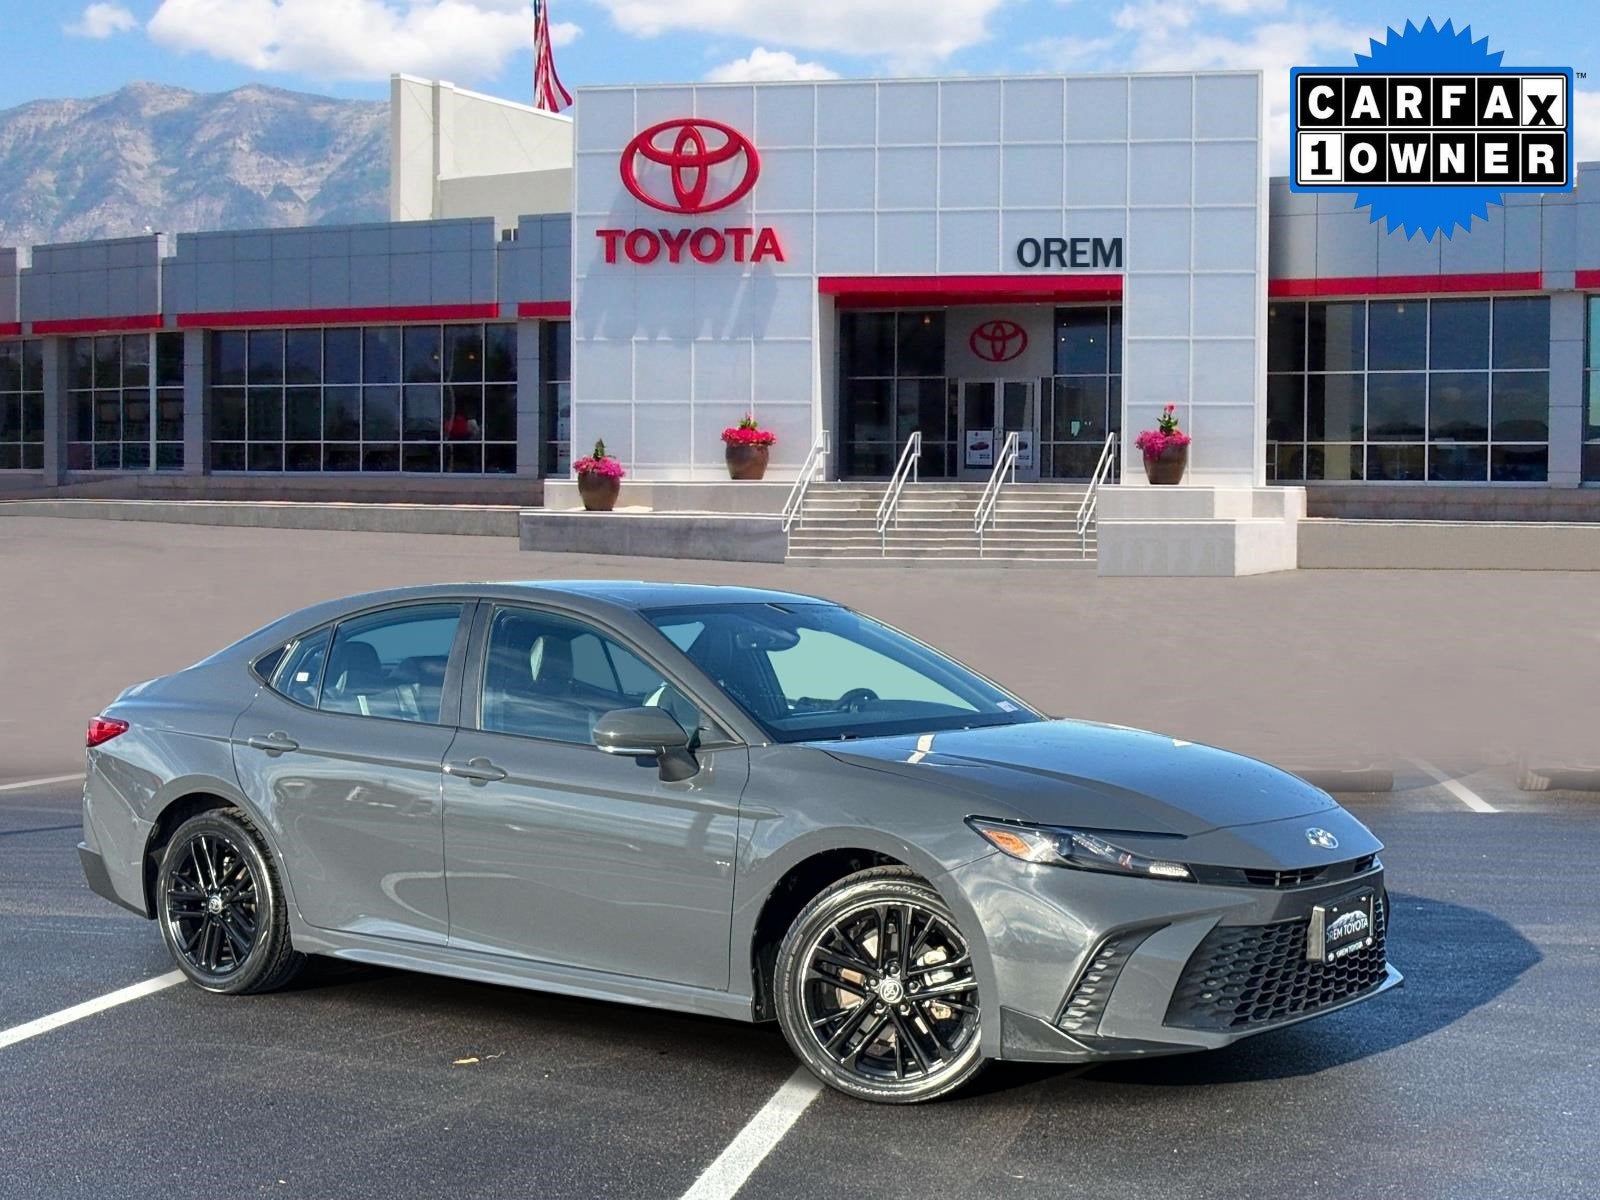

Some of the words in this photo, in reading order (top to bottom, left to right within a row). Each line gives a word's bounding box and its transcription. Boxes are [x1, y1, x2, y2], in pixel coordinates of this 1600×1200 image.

[595, 227, 785, 264] TOYOTA
[1016, 237, 1123, 268] OREM
[1343, 917, 1369, 936] TOYOTA
